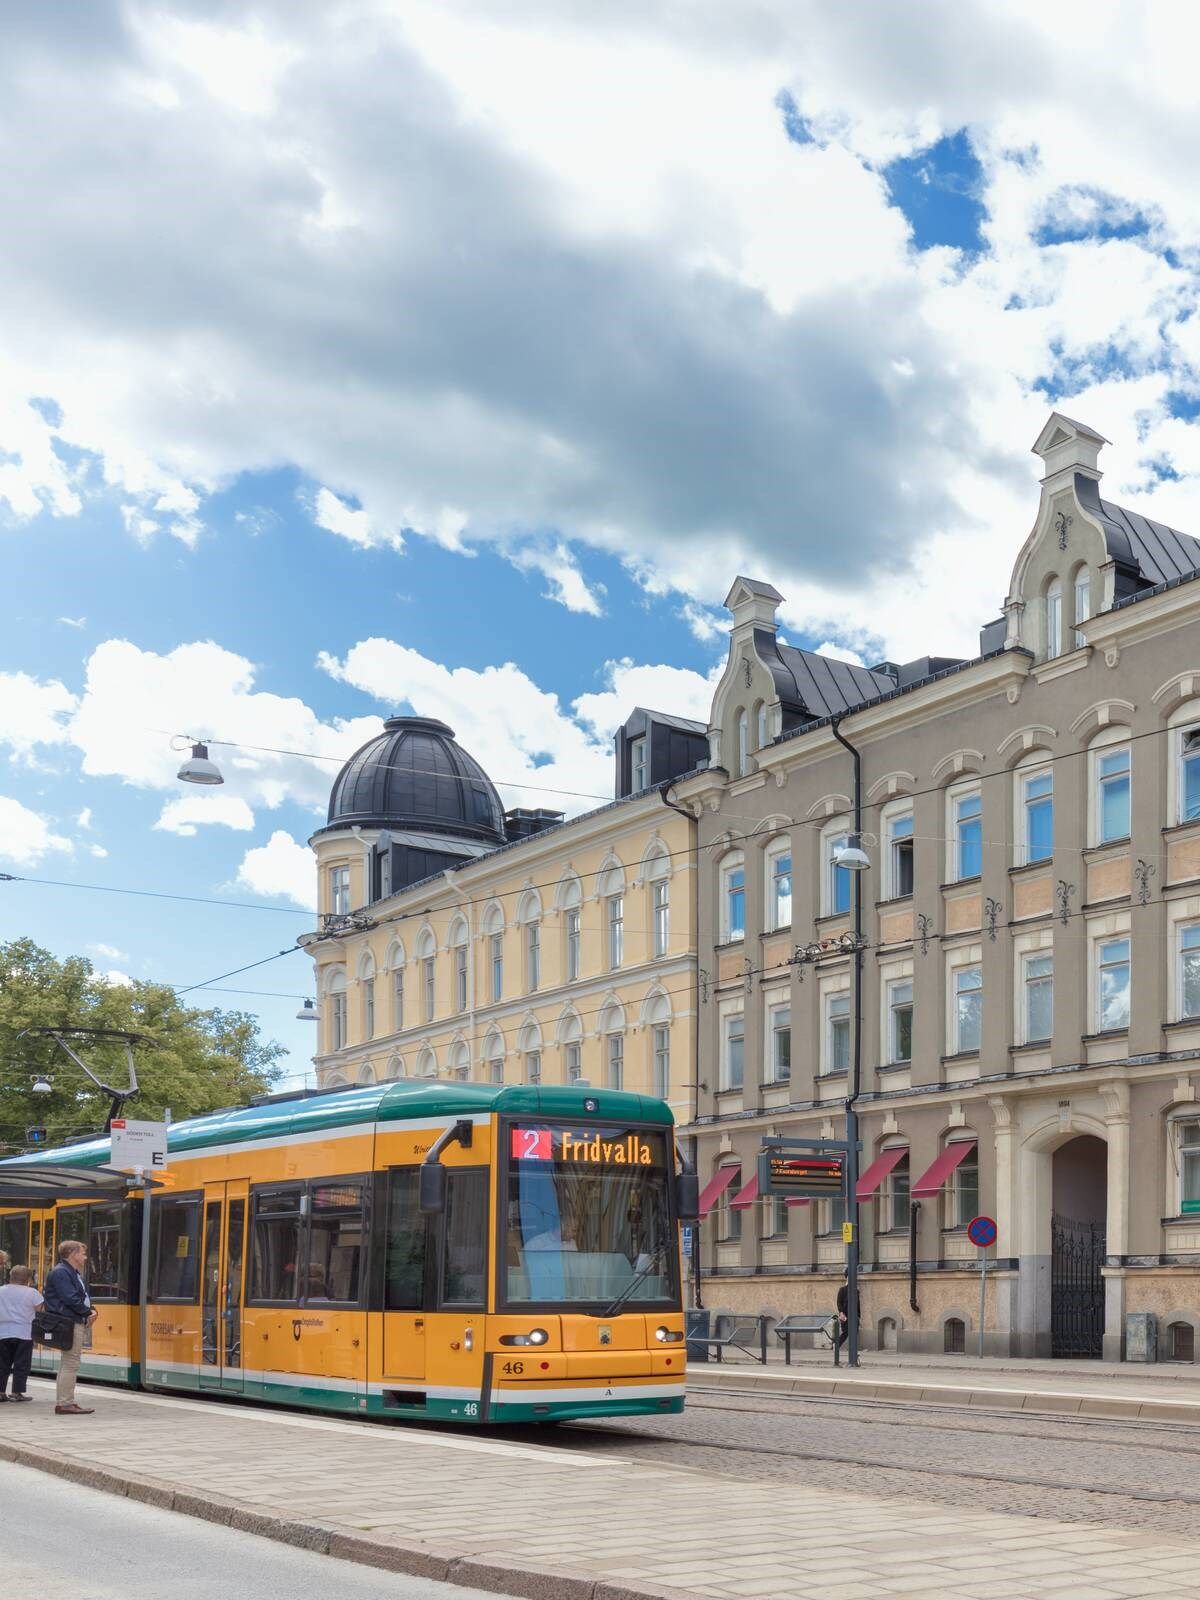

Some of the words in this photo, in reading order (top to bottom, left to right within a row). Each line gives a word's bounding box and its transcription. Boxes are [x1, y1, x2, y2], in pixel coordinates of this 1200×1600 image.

[523, 1129, 540, 1159] 2
[562, 1131, 652, 1165] Fridvalla
[152, 1152, 164, 1165] E
[502, 1362, 524, 1375] 46
[605, 1388, 612, 1396] A
[463, 1402, 478, 1416] 46
